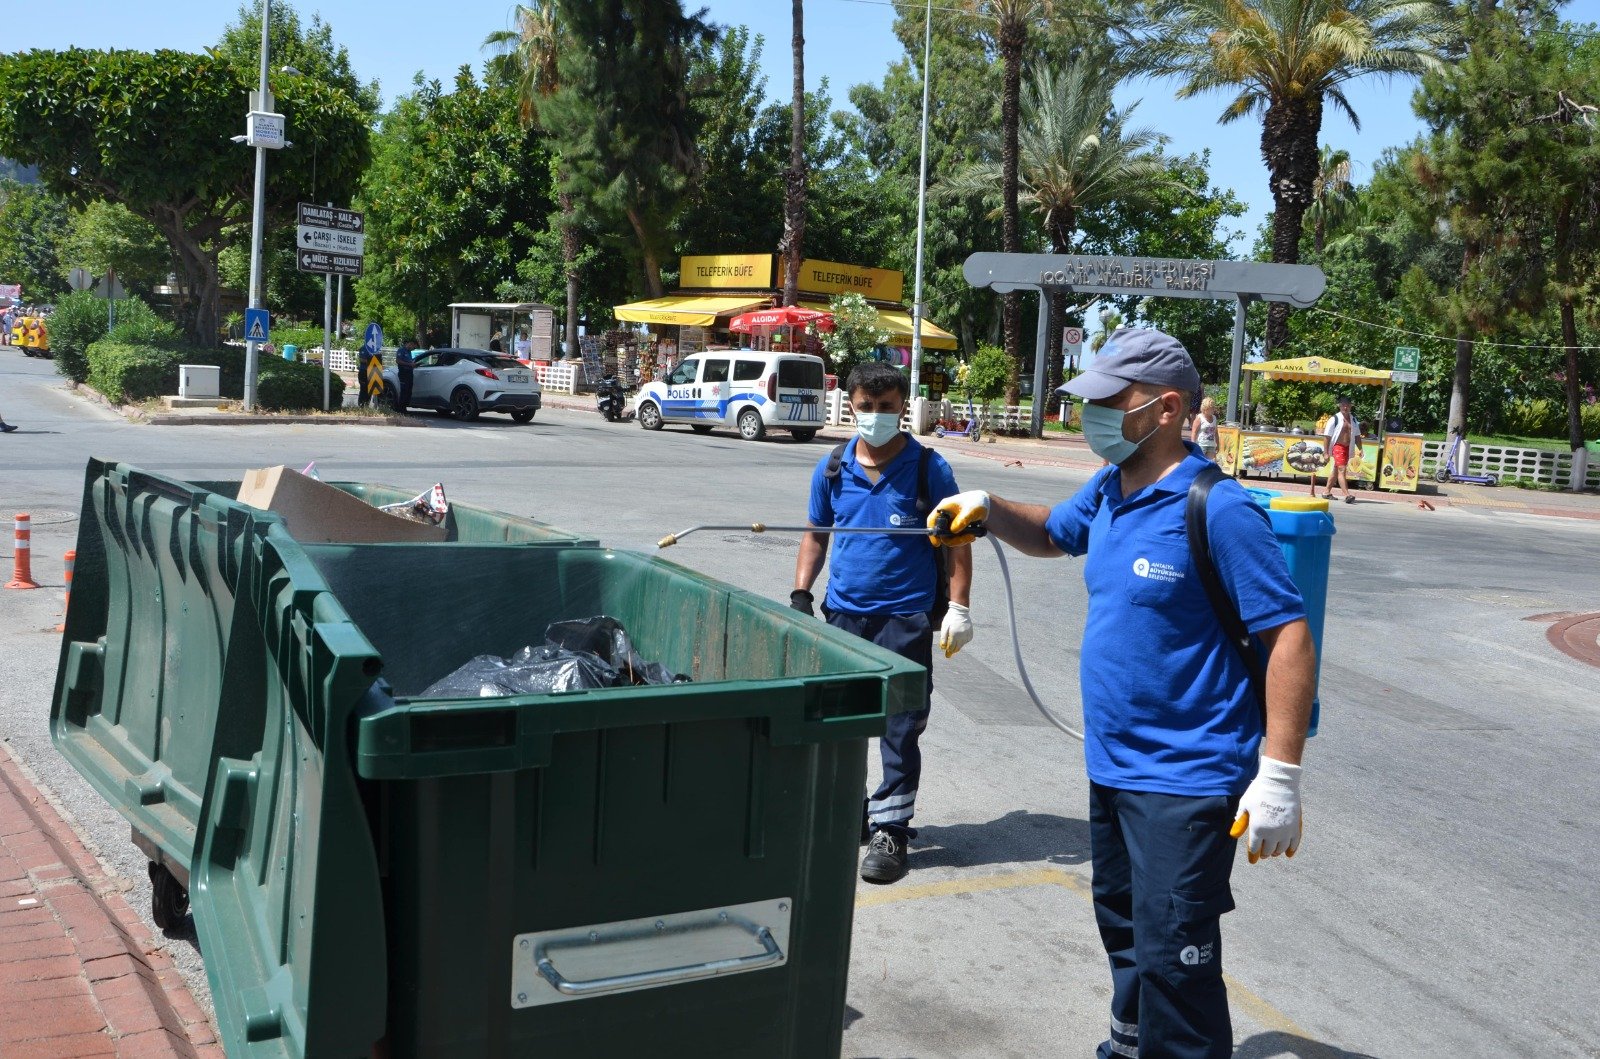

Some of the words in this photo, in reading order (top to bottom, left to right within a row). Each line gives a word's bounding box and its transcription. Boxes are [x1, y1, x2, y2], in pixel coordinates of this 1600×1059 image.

[303, 207, 333, 222] DAMLATAŞ
[338, 212, 353, 222] KALE
[337, 232, 357, 245] İSKELE
[312, 254, 329, 264] MÜZE
[333, 256, 360, 267] KIZILKULE
[1065, 258, 1123, 271] ALANYA
[1133, 260, 1214, 276] BELEDİYESİ
[697, 264, 733, 277] TELEFERİK
[734, 264, 754, 277] BÜFE
[812, 270, 852, 285] TELEFERİK
[853, 274, 873, 288] BÜFE
[1098, 271, 1152, 288] ATATÜRK
[1165, 275, 1207, 290] PARKI
[751, 315, 777, 323] ALGIDA
[1323, 367, 1367, 376] BELEDİYESİ
[667, 387, 690, 399] POLİS
[1150, 562, 1174, 570] ANTALYA
[1147, 573, 1178, 583] BELEDİYESİ
[1149, 567, 1185, 579] BÜYÜKŞEHİR
